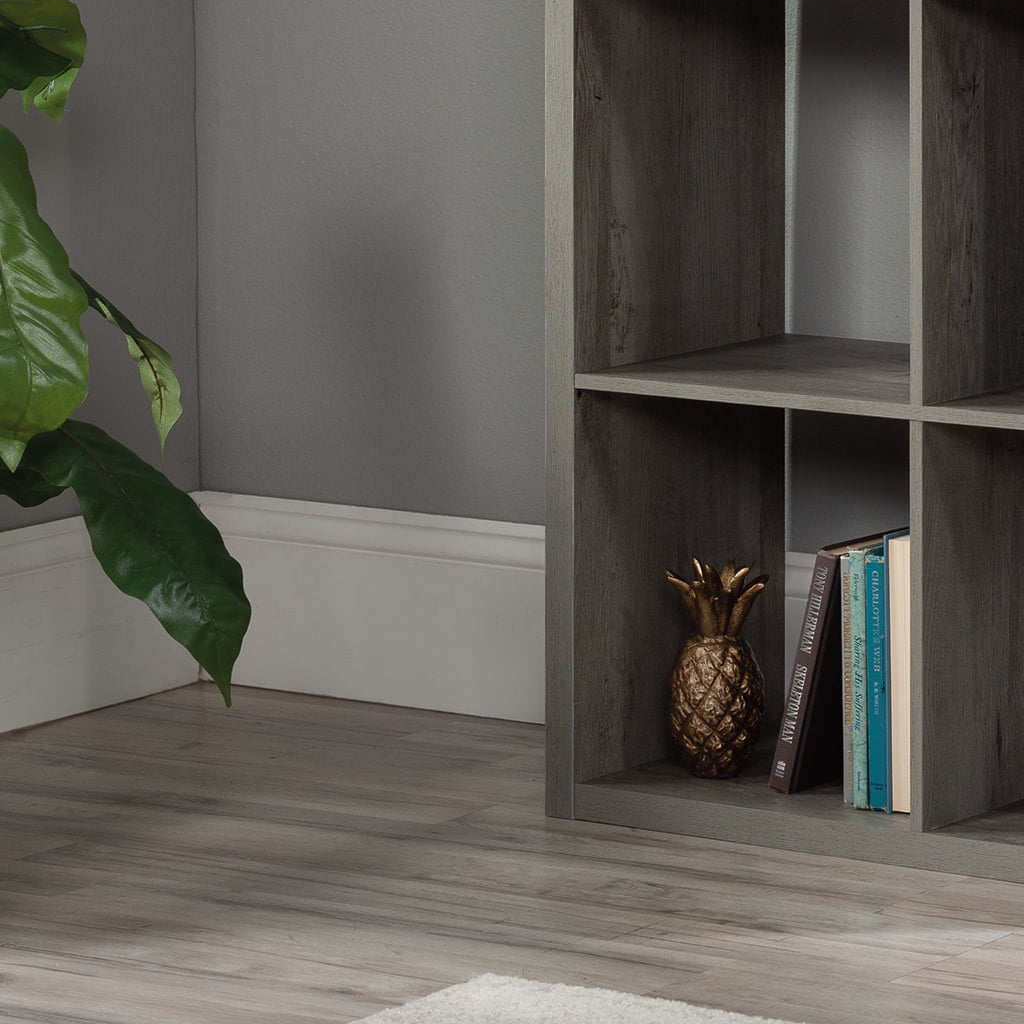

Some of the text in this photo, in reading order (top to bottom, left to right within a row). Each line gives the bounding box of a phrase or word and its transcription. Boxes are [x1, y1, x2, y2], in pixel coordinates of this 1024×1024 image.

[799, 566, 829, 655] TONY HILLERMAN
[853, 634, 864, 732] Sharing His Suffering
[873, 645, 881, 673] WEB
[781, 663, 808, 745] SKELETON MAN
